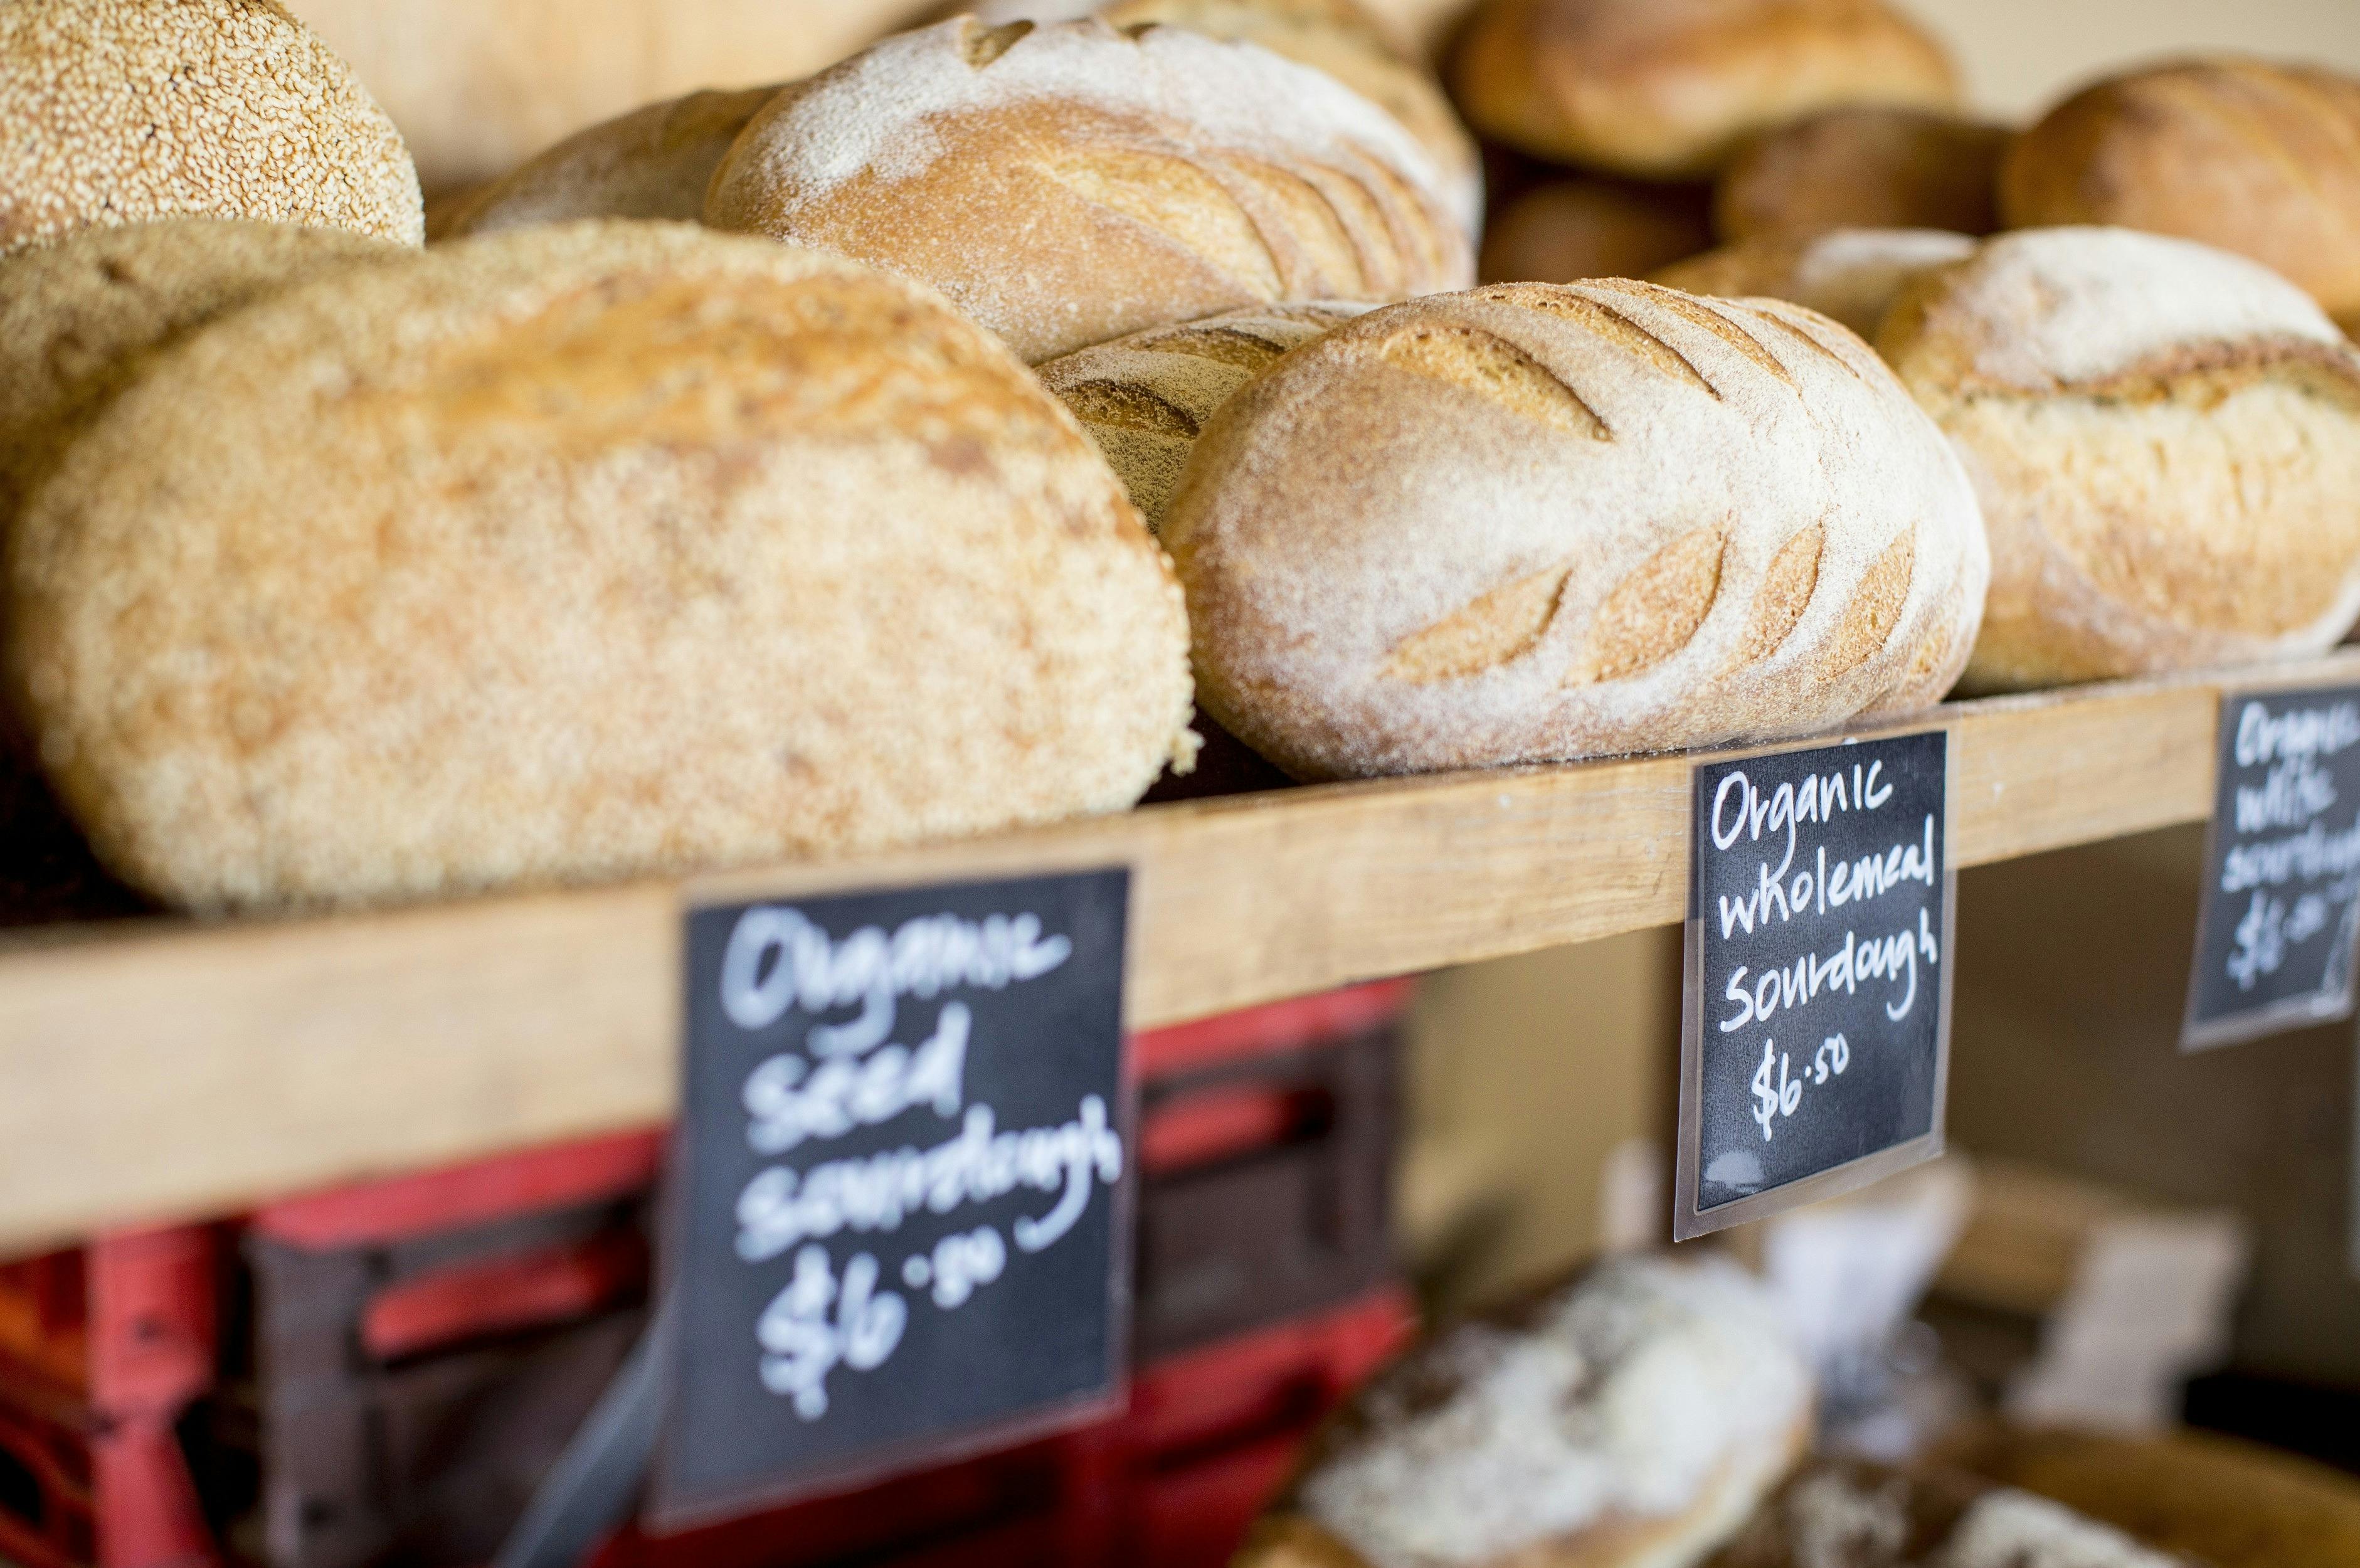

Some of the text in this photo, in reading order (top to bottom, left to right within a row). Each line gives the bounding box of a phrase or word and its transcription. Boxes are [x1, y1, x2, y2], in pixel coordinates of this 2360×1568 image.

[1710, 760, 1893, 879] Organic
[1718, 813, 1934, 940] wholemeal
[722, 906, 1071, 1057] Organic
[1720, 908, 1939, 1032] sourdough
[744, 1003, 971, 1153] seed
[736, 1095, 1121, 1261] sourdough
